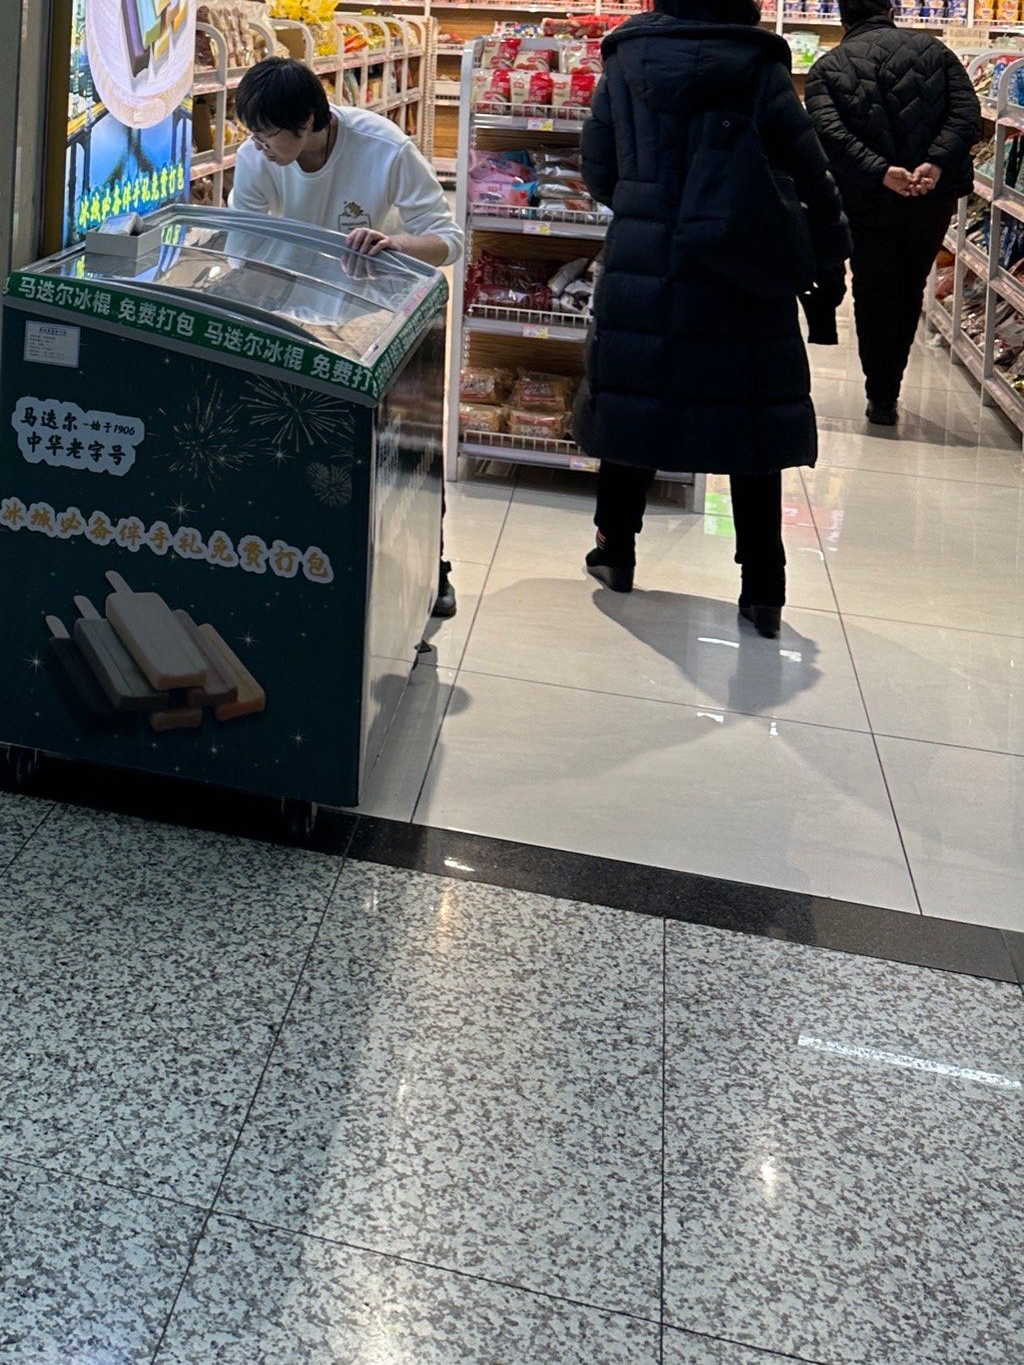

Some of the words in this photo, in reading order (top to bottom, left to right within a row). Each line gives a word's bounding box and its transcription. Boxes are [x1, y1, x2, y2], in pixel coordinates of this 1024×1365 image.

[18, 276, 112, 316] 马迭尔冰棍
[118, 297, 196, 337] 免费打包
[204, 320, 305, 371] 马迭尔冰棍
[26, 430, 126, 466] 中华老字号
[3, 501, 331, 578] 冰城必备伴手礼免费打包
